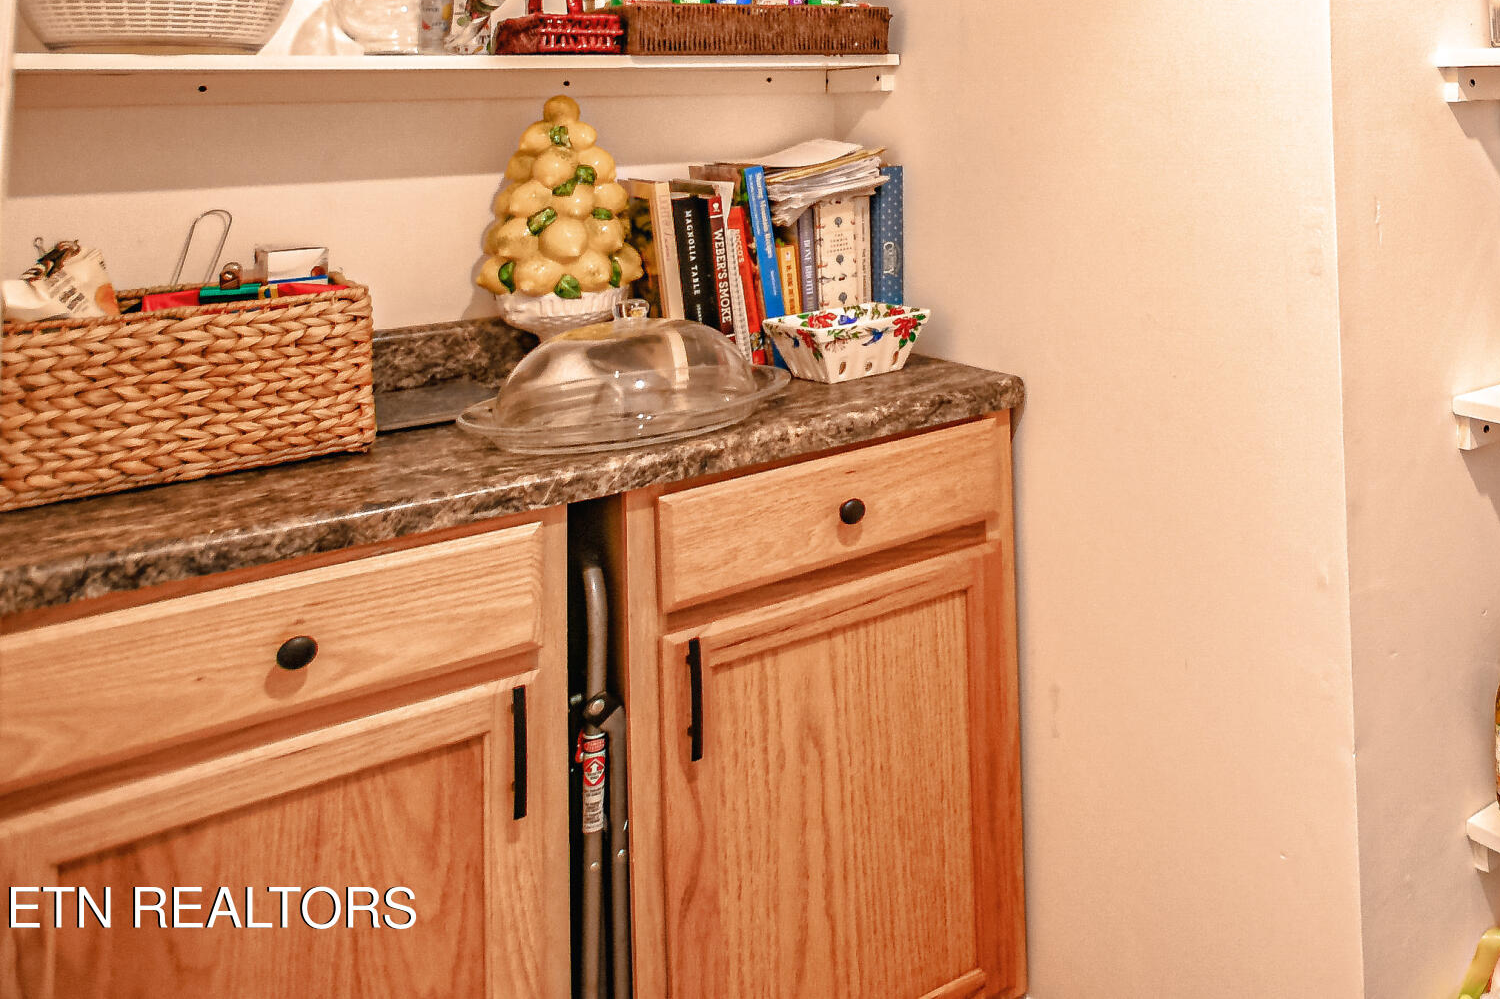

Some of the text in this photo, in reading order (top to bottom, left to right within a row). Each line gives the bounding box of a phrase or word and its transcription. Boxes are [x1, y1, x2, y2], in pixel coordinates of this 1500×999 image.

[683, 209, 698, 262] MAGNOLIA
[690, 264, 701, 296] TABLE
[713, 228, 732, 324] WEBER'S SMOKE
